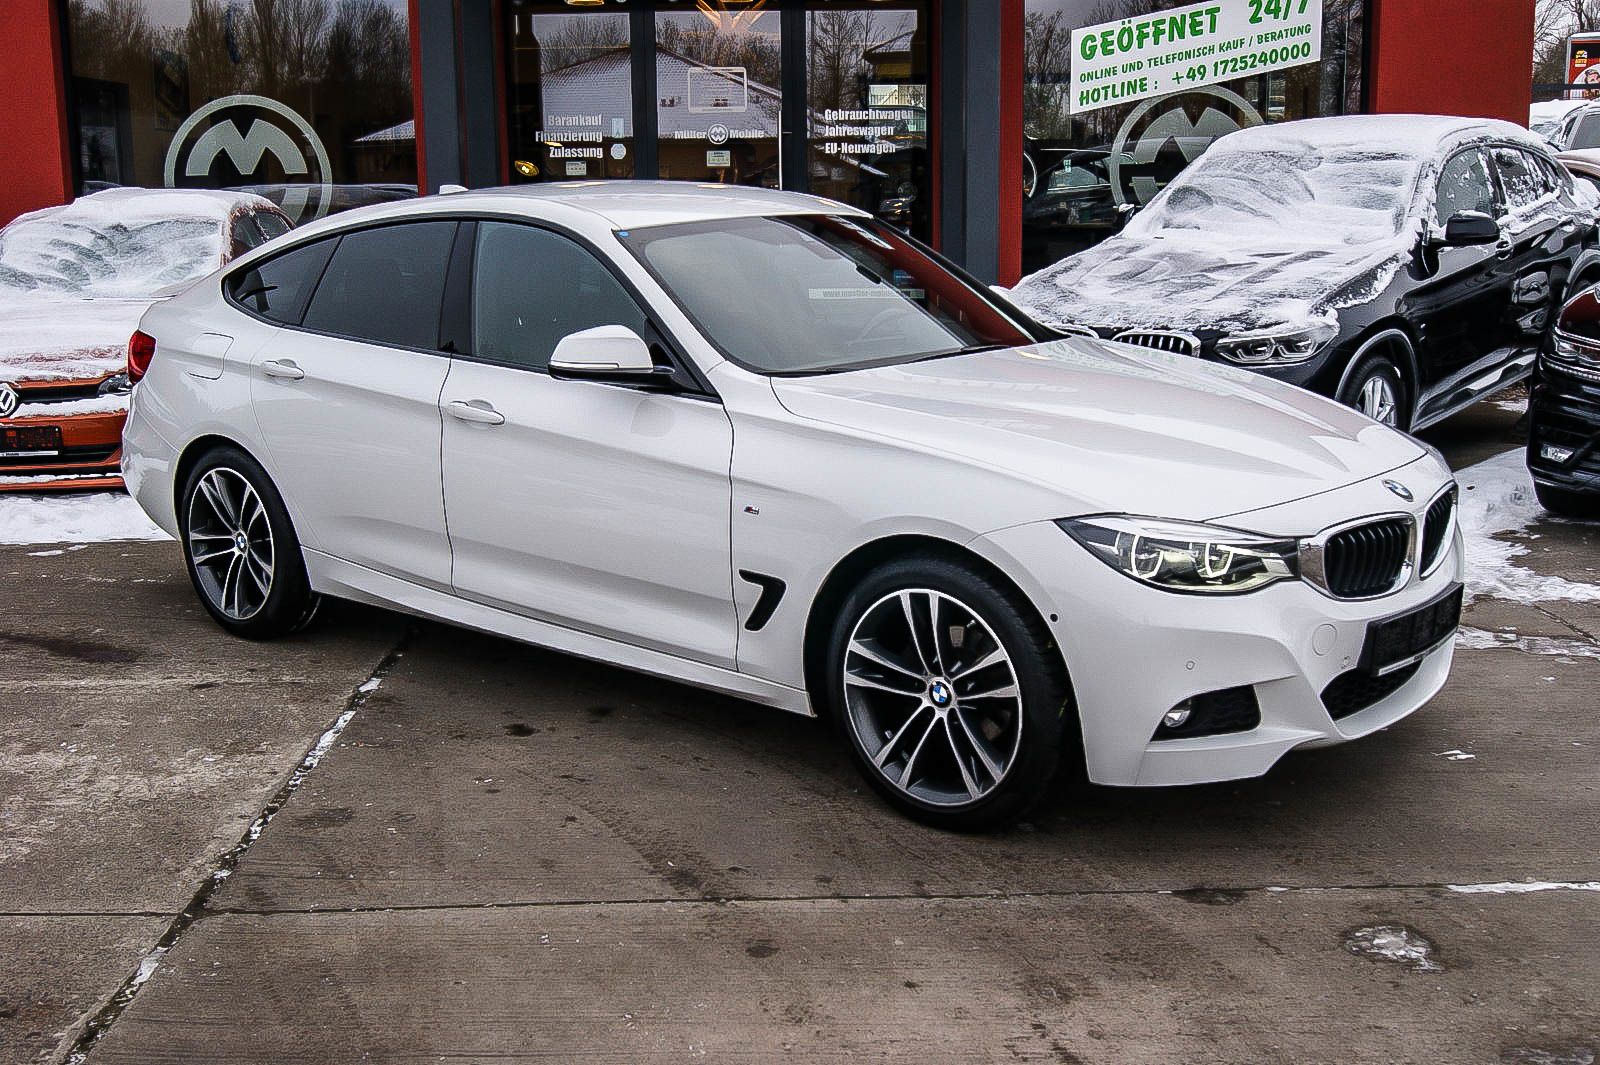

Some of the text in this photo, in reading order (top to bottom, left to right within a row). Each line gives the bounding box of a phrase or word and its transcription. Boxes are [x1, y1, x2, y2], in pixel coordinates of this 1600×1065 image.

[1081, 7, 1220, 60] GEÖFFNET
[1080, 66, 1117, 82] ONLINE
[1122, 60, 1143, 73] UND
[1147, 45, 1215, 68] TELEFONISCH
[1219, 38, 1245, 52] KAUF
[1257, 24, 1311, 44] BERATUNG
[1079, 77, 1147, 106] HOTLINE
[1172, 64, 1206, 84] +49
[1213, 42, 1311, 77] 1725240000
[824, 109, 914, 121] Gebrauchtwagen
[535, 131, 603, 142] Finanzierung
[729, 129, 764, 139] Mobile
[824, 125, 895, 136] Jahreswagen
[549, 147, 603, 158] Zulassung
[825, 142, 896, 154] EU-Neuwagen
